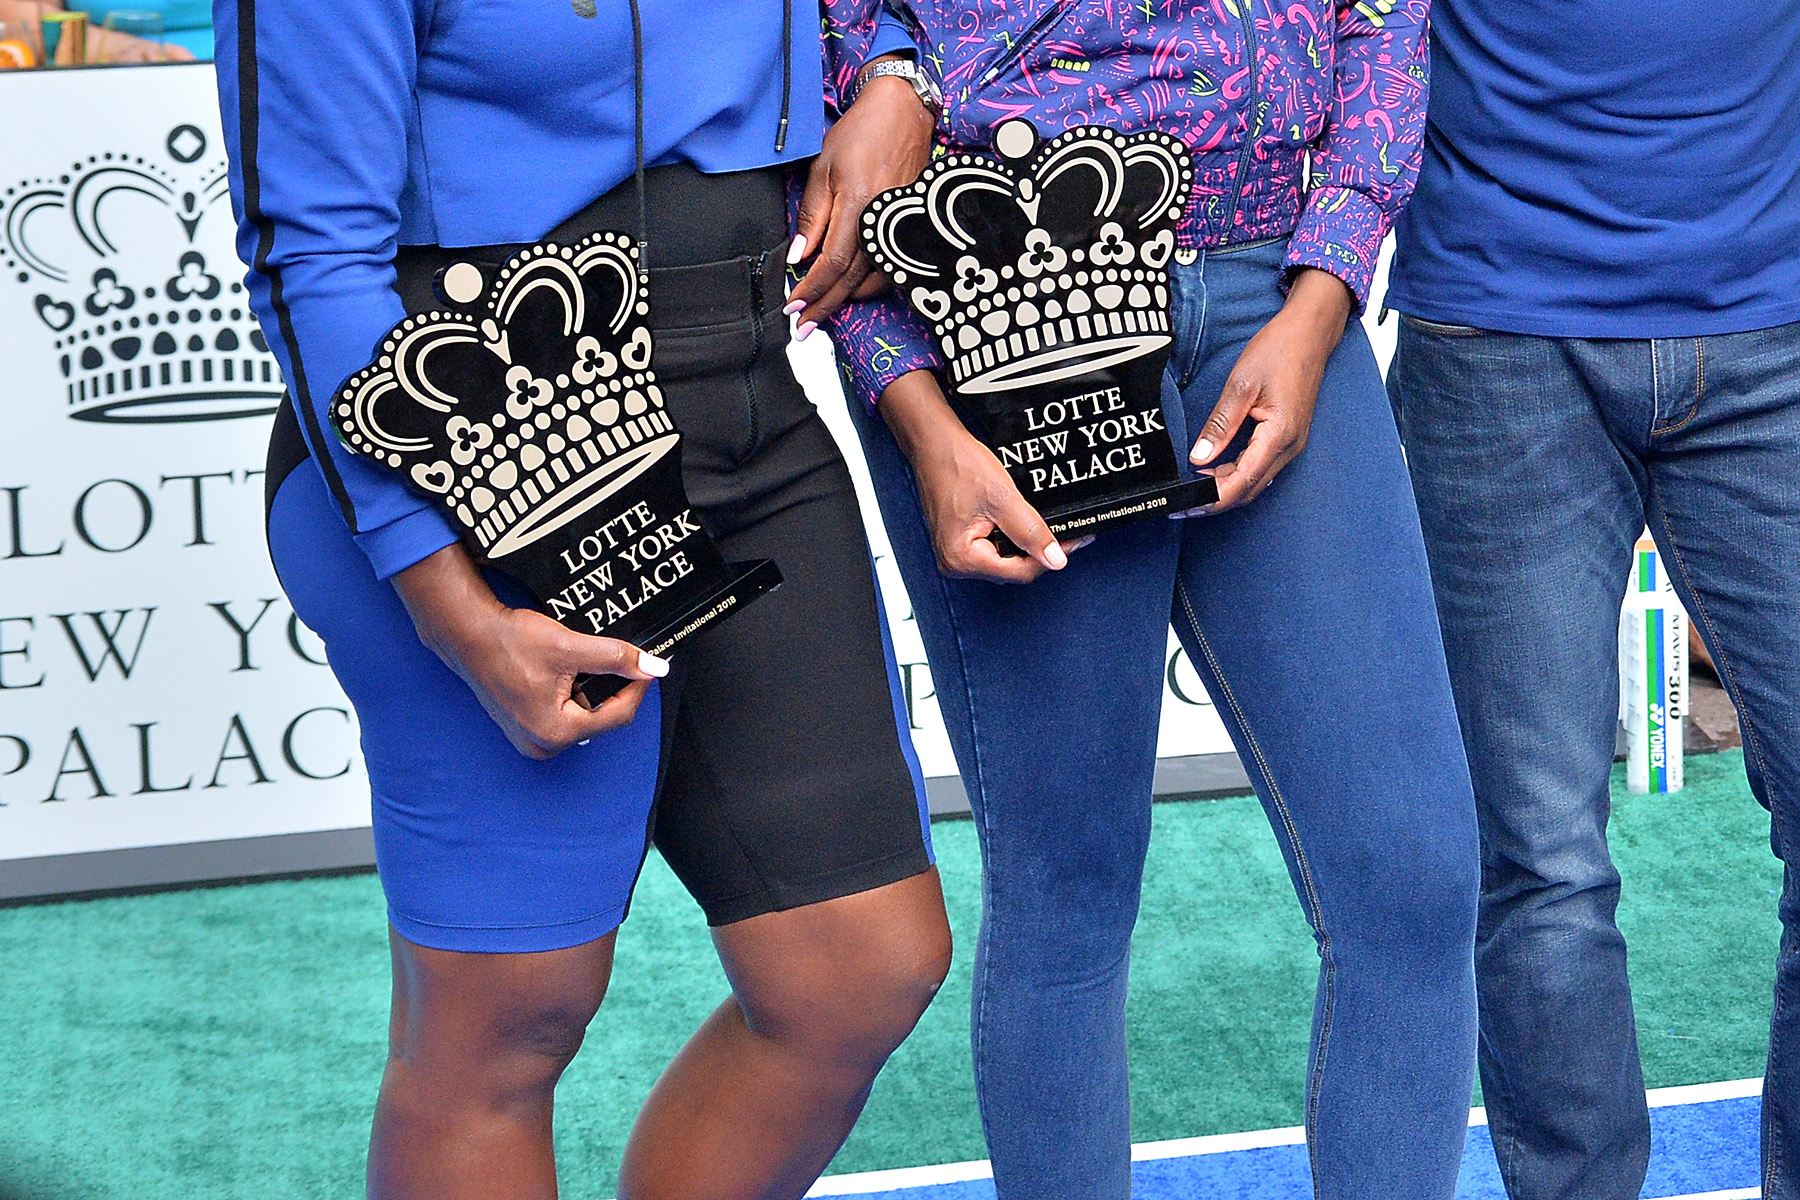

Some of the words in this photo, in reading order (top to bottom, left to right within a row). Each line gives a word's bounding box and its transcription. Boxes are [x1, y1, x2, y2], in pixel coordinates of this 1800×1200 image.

[998, 431, 1069, 468] NEW
[1078, 408, 1165, 448] YORK
[1024, 387, 1125, 431] LOTTE
[1030, 443, 1146, 492] PALACE
[1, 470, 265, 560] LOT
[560, 501, 657, 575] LOTTE
[1049, 522, 1066, 533] The
[1068, 516, 1096, 529] Palace
[1098, 503, 1145, 522] Invitational
[1146, 497, 1167, 509] 2018
[547, 561, 614, 621] NEW
[618, 509, 701, 572] YORK
[584, 551, 694, 634] PALACE
[648, 637, 674, 657] Palace
[674, 609, 717, 641] Invitational
[716, 595, 737, 614] 2018
[1668, 614, 1680, 671] MAVIS
[1668, 675, 1682, 720] 300
[1649, 727, 1666, 769] YONEX
